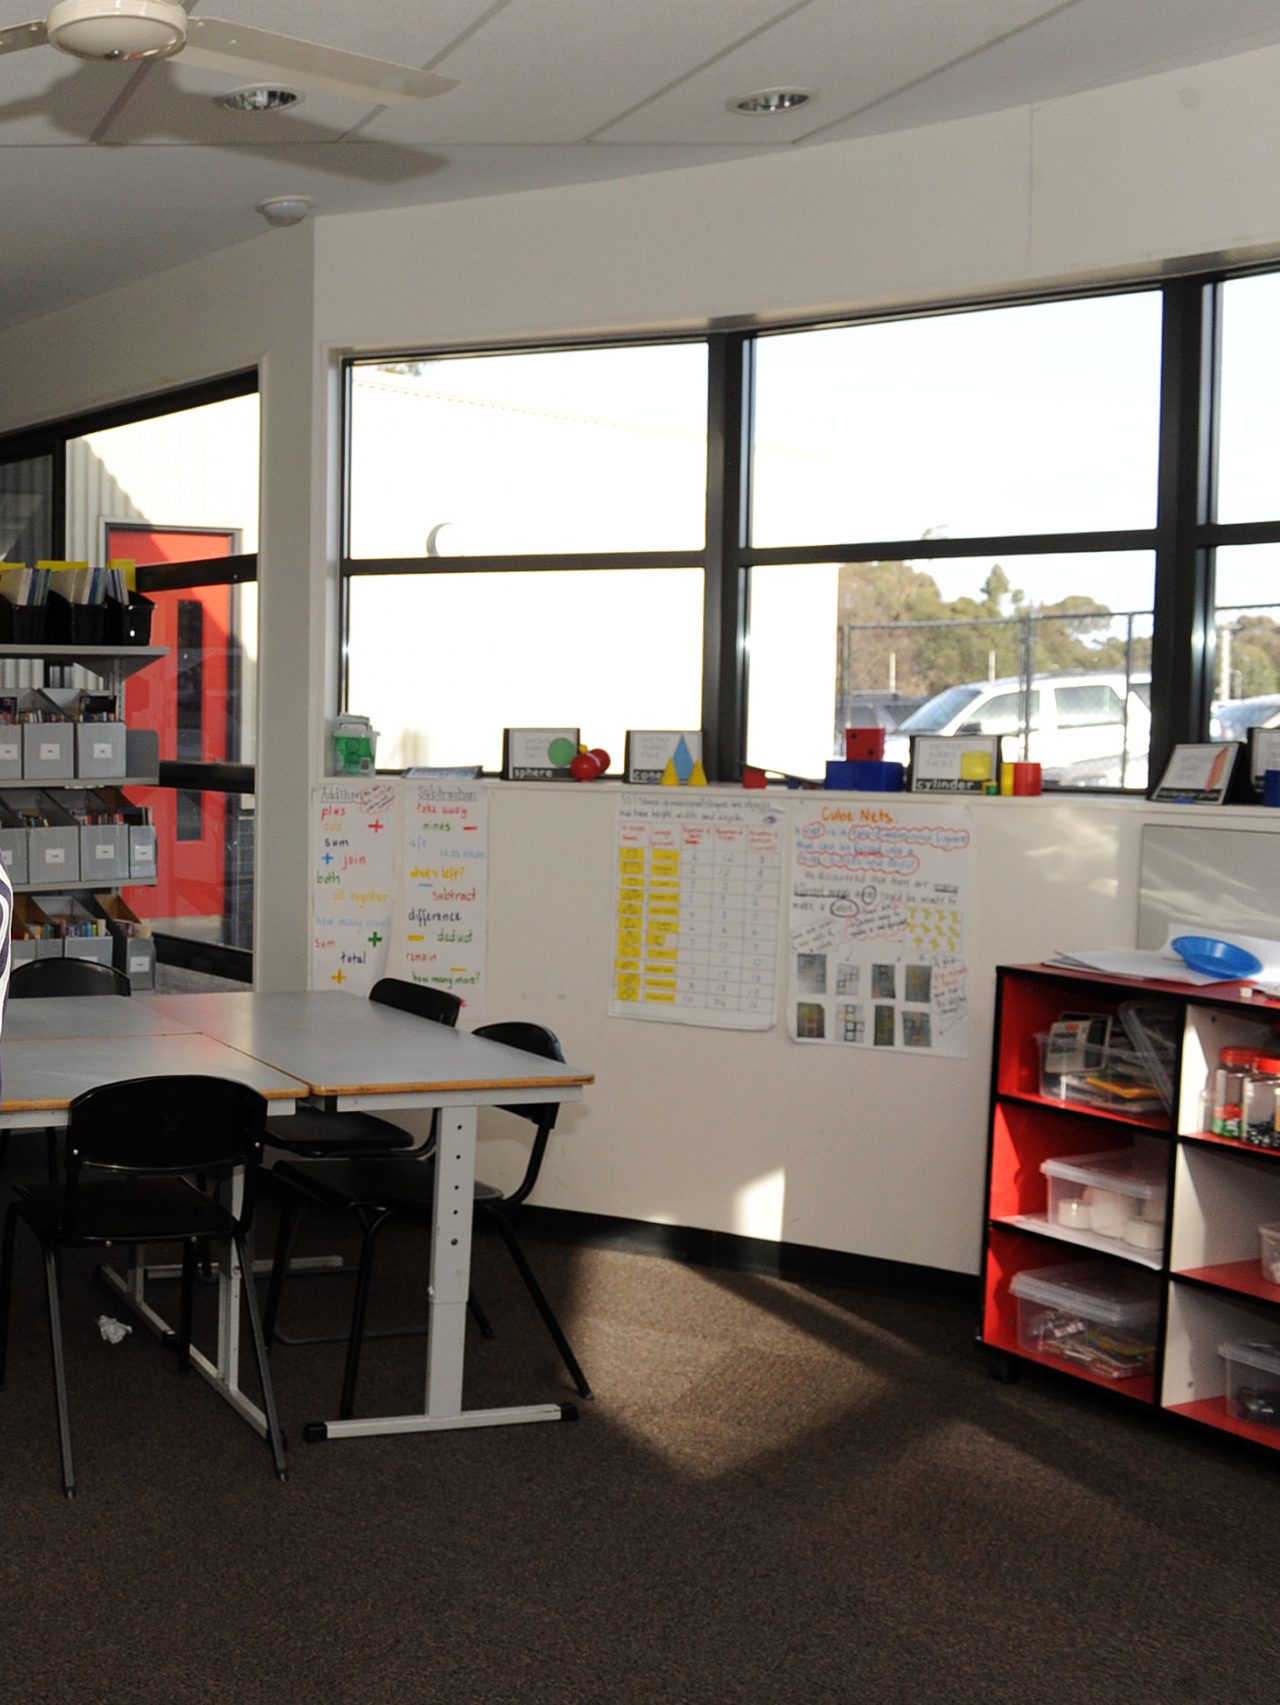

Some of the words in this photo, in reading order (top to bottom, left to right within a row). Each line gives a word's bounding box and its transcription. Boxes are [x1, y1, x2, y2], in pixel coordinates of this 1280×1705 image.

[514, 767, 553, 779] sphere
[917, 778, 974, 791] cylinder
[320, 806, 347, 821] plus
[442, 807, 468, 819] away
[822, 806, 854, 822] Cube
[860, 809, 894, 824] Nets
[324, 838, 349, 847] sum
[342, 854, 367, 870] join
[316, 871, 341, 884] both
[432, 888, 477, 901] subtract
[408, 908, 461, 927] difference
[437, 930, 473, 943] deduct
[341, 952, 366, 964] total
[406, 953, 437, 962] remain
